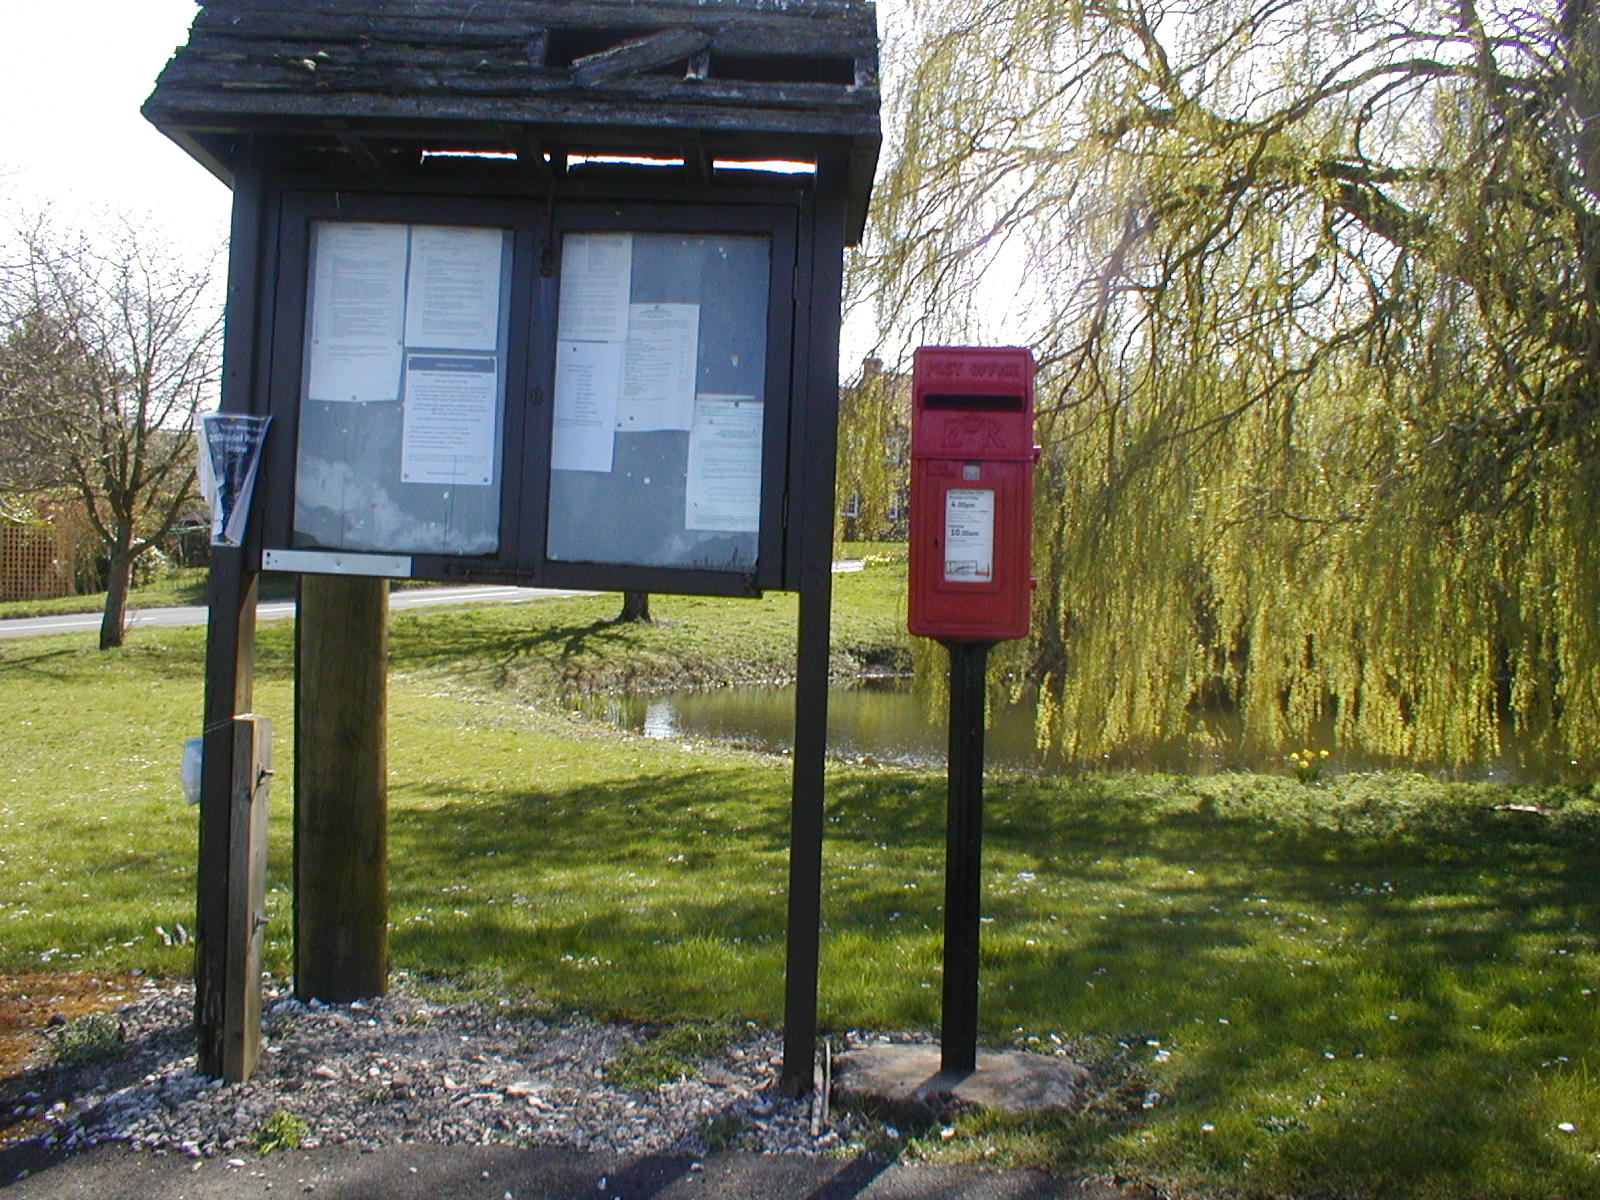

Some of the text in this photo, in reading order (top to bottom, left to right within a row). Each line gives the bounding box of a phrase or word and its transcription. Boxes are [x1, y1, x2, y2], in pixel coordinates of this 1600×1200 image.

[927, 362, 1020, 378] POST OFFICE
[951, 500, 976, 509] 4.00pm
[950, 528, 980, 537] 10.00am
